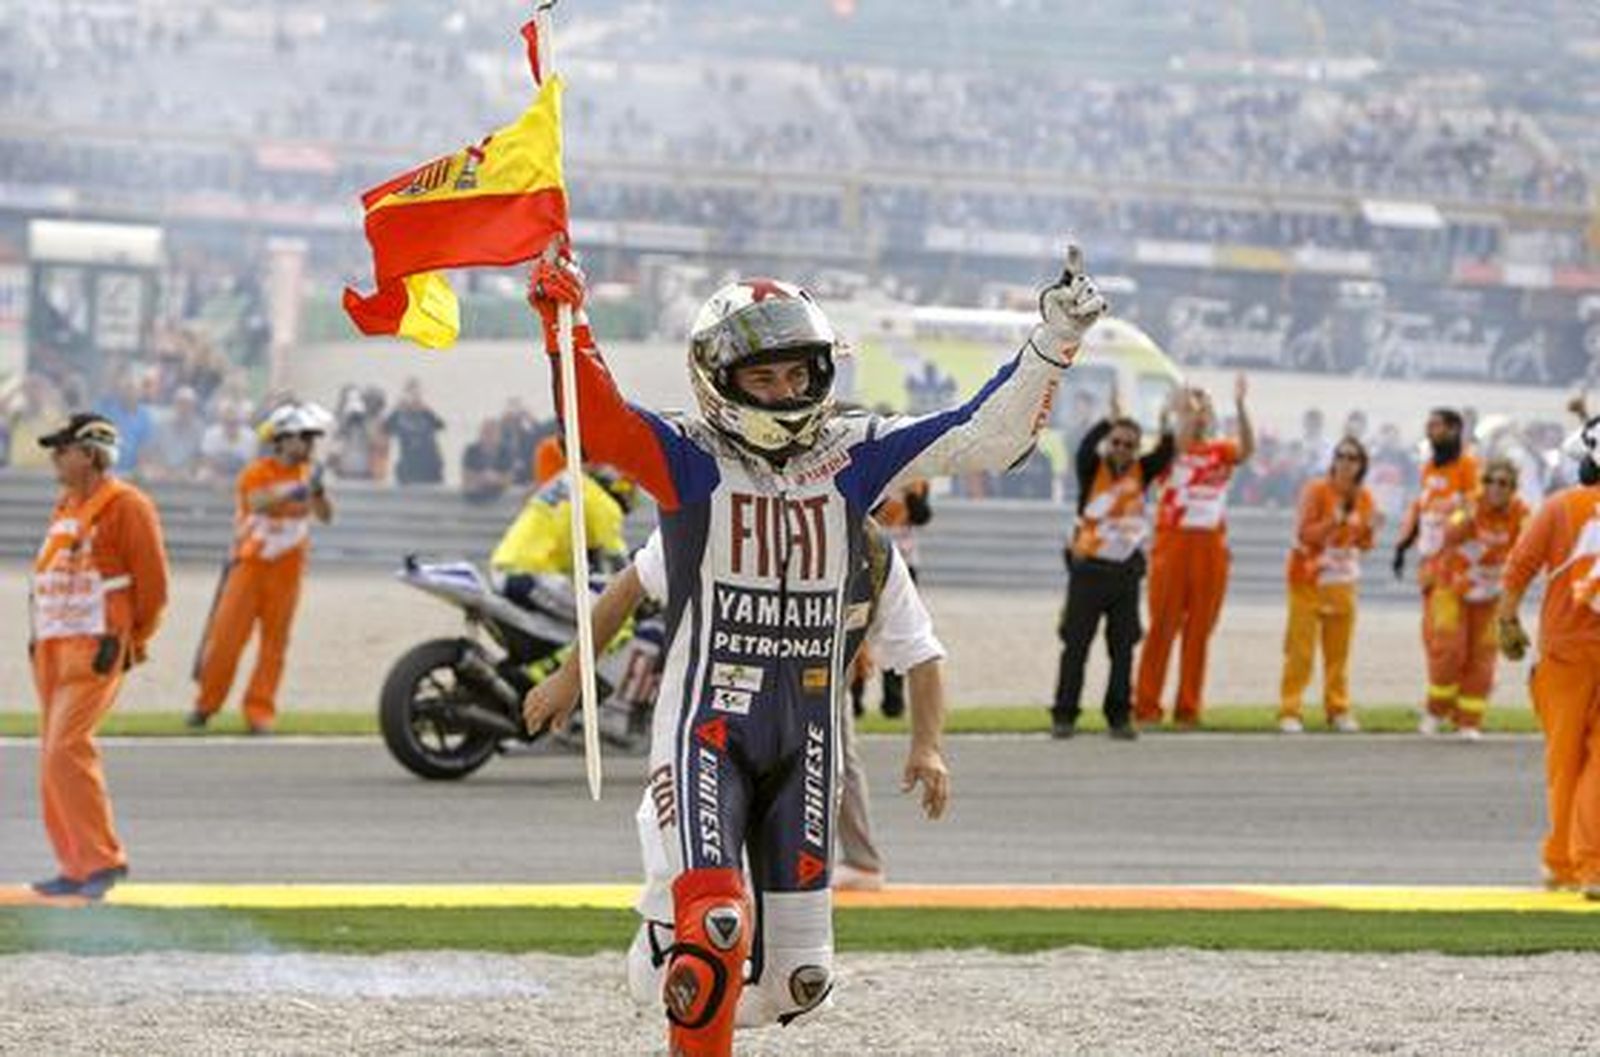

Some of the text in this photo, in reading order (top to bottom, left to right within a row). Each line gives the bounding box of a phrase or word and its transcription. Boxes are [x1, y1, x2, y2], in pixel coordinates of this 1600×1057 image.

[730, 492, 829, 581] FIAT
[717, 589, 835, 628] YAMAHA
[713, 632, 832, 658] PETRONAS
